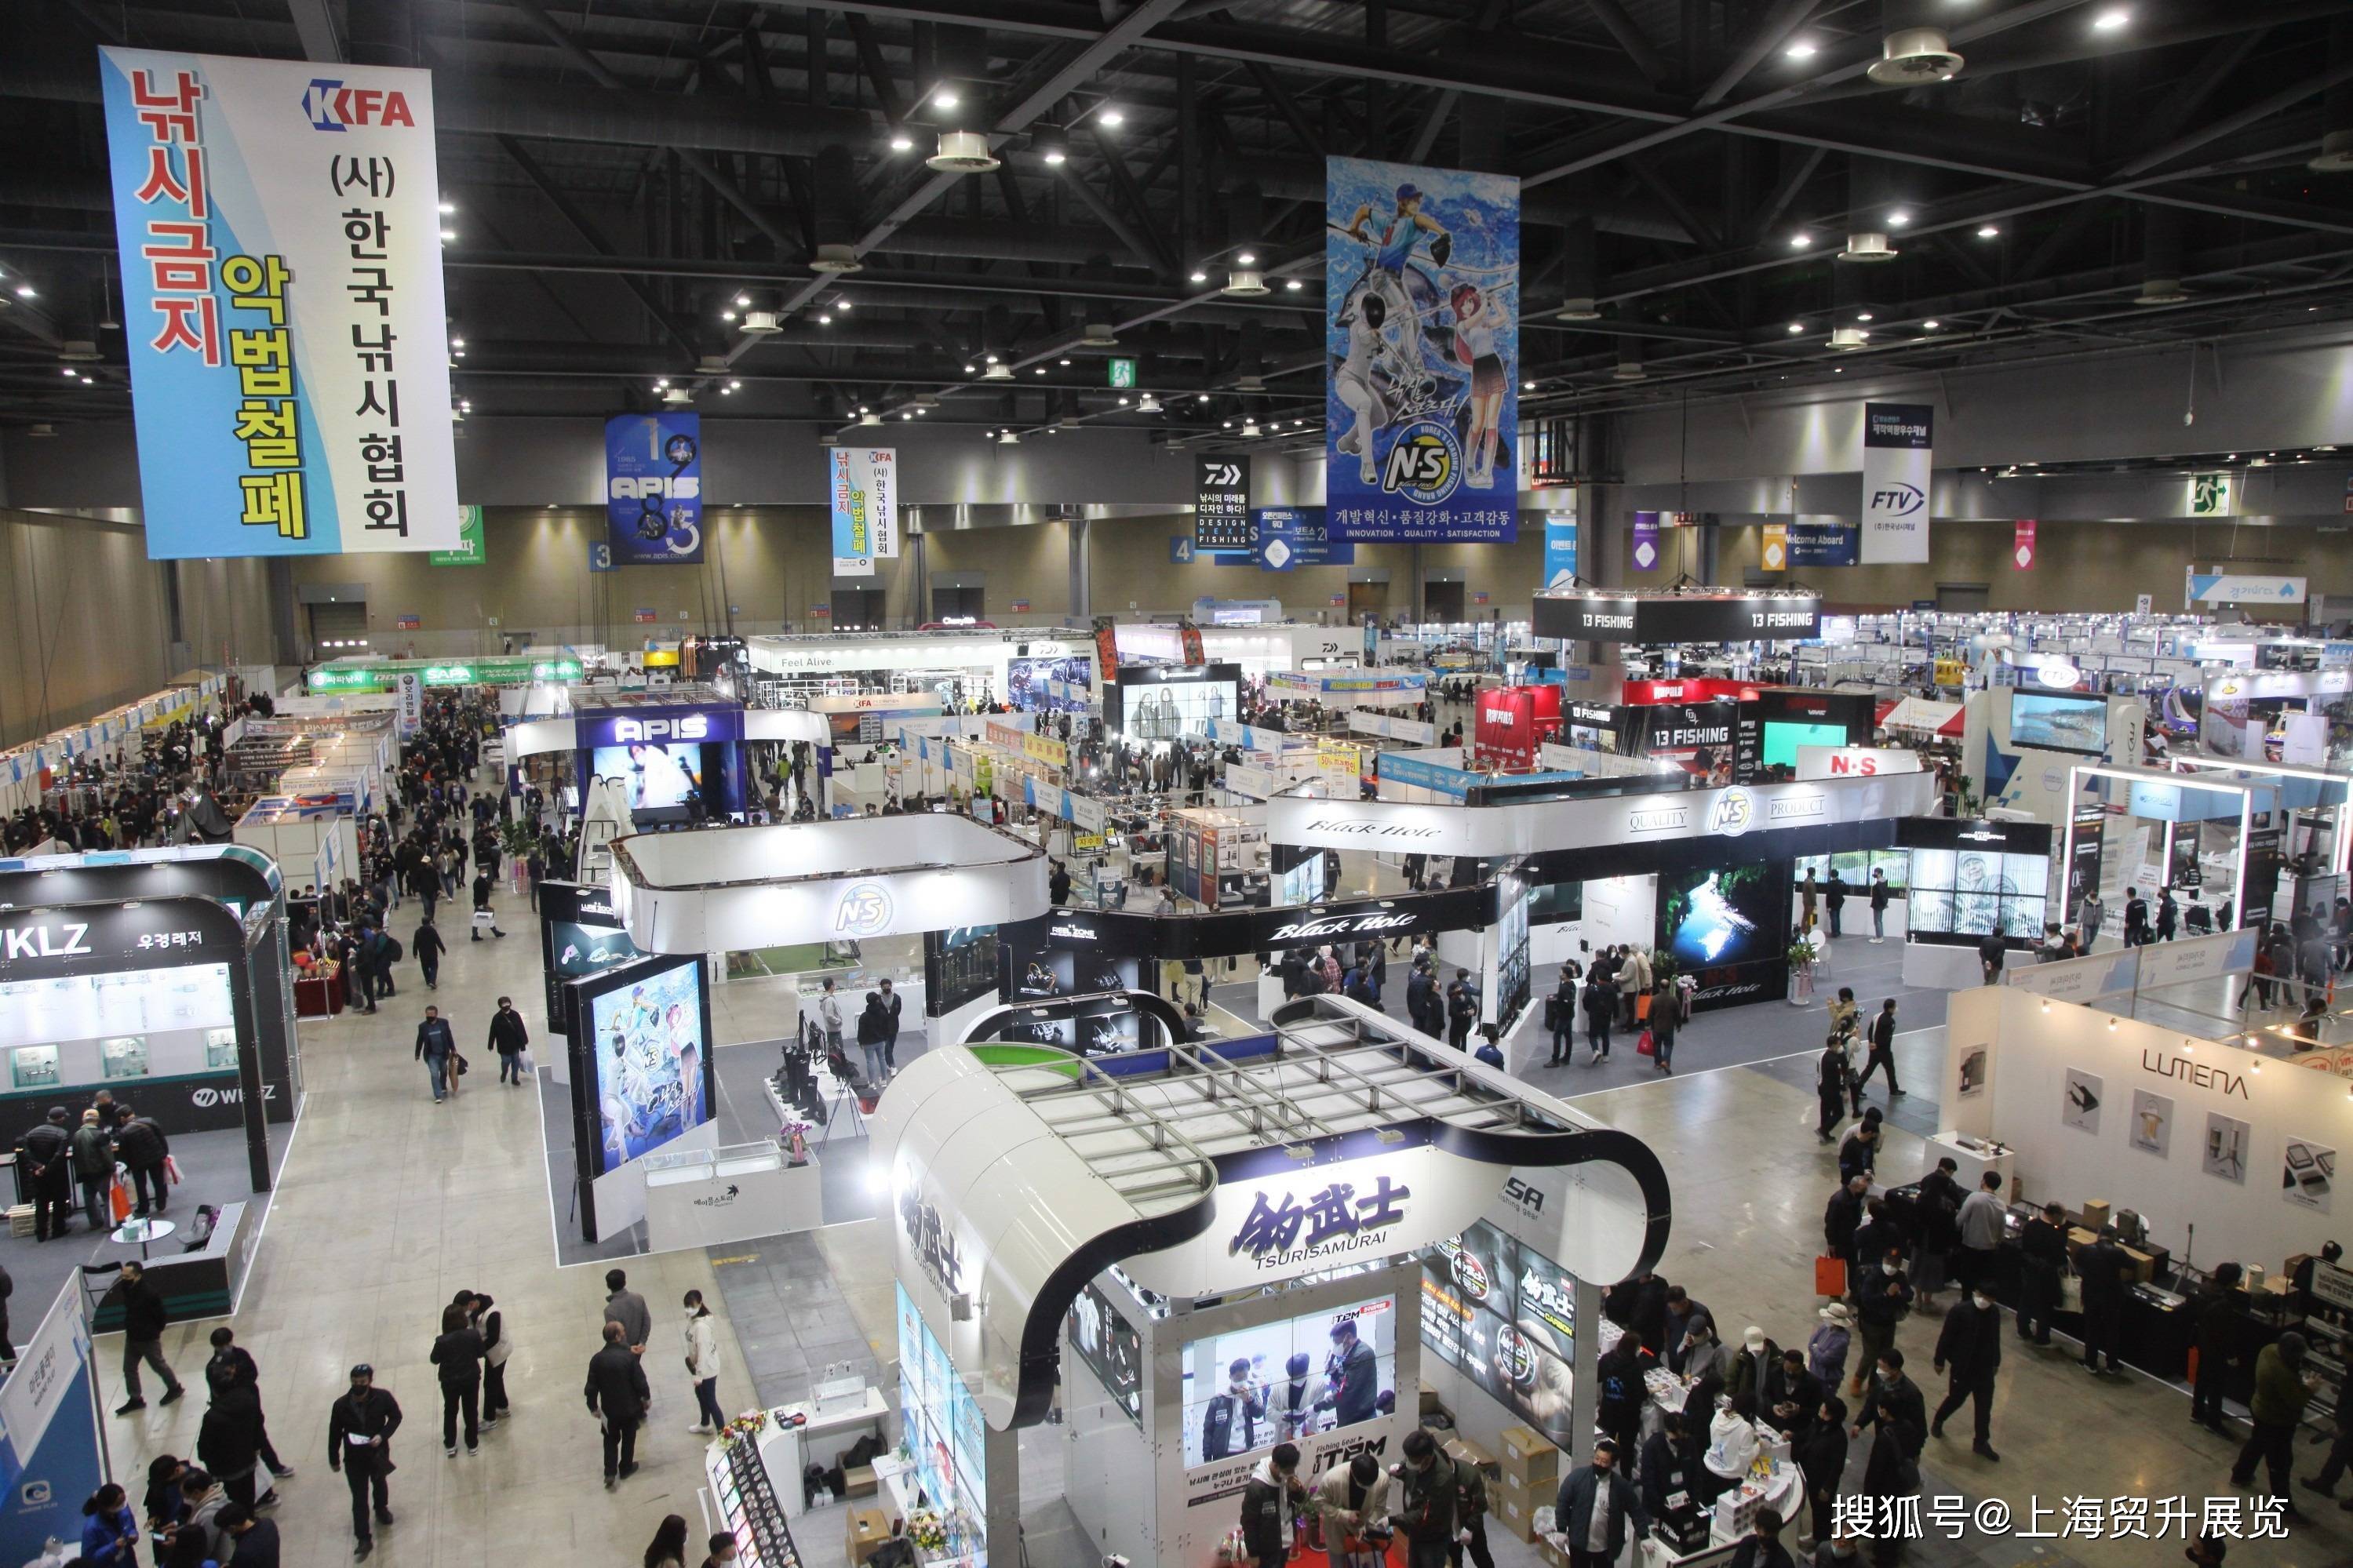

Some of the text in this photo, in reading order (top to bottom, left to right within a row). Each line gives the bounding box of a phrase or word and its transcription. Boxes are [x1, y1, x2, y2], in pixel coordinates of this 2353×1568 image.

[132, 70, 220, 366] 낚시금지
[331, 155, 409, 537] (사)한국낚시협회
[220, 255, 306, 540] 악법철폐
[610, 477, 699, 499] APIS
[836, 452, 850, 515] 낚시금지
[1200, 493, 1222, 502] 낚시의
[1871, 492, 1911, 508] FTV
[874, 468, 887, 554] (사)한국낚시협회
[1200, 505, 1245, 514] 디자인 하다!
[1336, 510, 1510, 526] 개발혁신 품질강화 고객감동
[851, 490, 865, 554] 악법철폐
[1786, 535, 1843, 544] Welcome Aboard
[596, 544, 610, 568] 3
[1177, 540, 1189, 560] 4
[1583, 613, 1634, 629] 13 FISHING
[1752, 612, 1812, 628] 13 FISHING
[781, 658, 803, 667] Feel
[426, 668, 471, 679] SAPA
[1572, 707, 1611, 722] 13 FISHING
[615, 718, 707, 742] APIS
[1655, 727, 1728, 746] 13 FISHING
[1771, 798, 1824, 816] PRODUCT
[1306, 820, 1442, 838] Black Hole
[1630, 812, 1687, 831] QUALITY
[1268, 912, 1418, 941] Black Hole
[1557, 923, 1581, 933] Blac
[0, 922, 91, 959] KLZ
[1692, 983, 1761, 1000] lack Hole
[2143, 1049, 2249, 1101] LUMENA
[220, 1086, 276, 1104] WZ
[1523, 1208, 1539, 1221] gear
[1255, 1231, 1387, 1270] TSURISAMURAI
[910, 1242, 951, 1308] TSURISAMU
[1317, 1438, 1356, 1452] Fishing Gear
[1189, 1474, 1210, 1486] 낚시에
[1212, 1468, 1232, 1481] 관심이
[1213, 1479, 1233, 1490] 누구나
